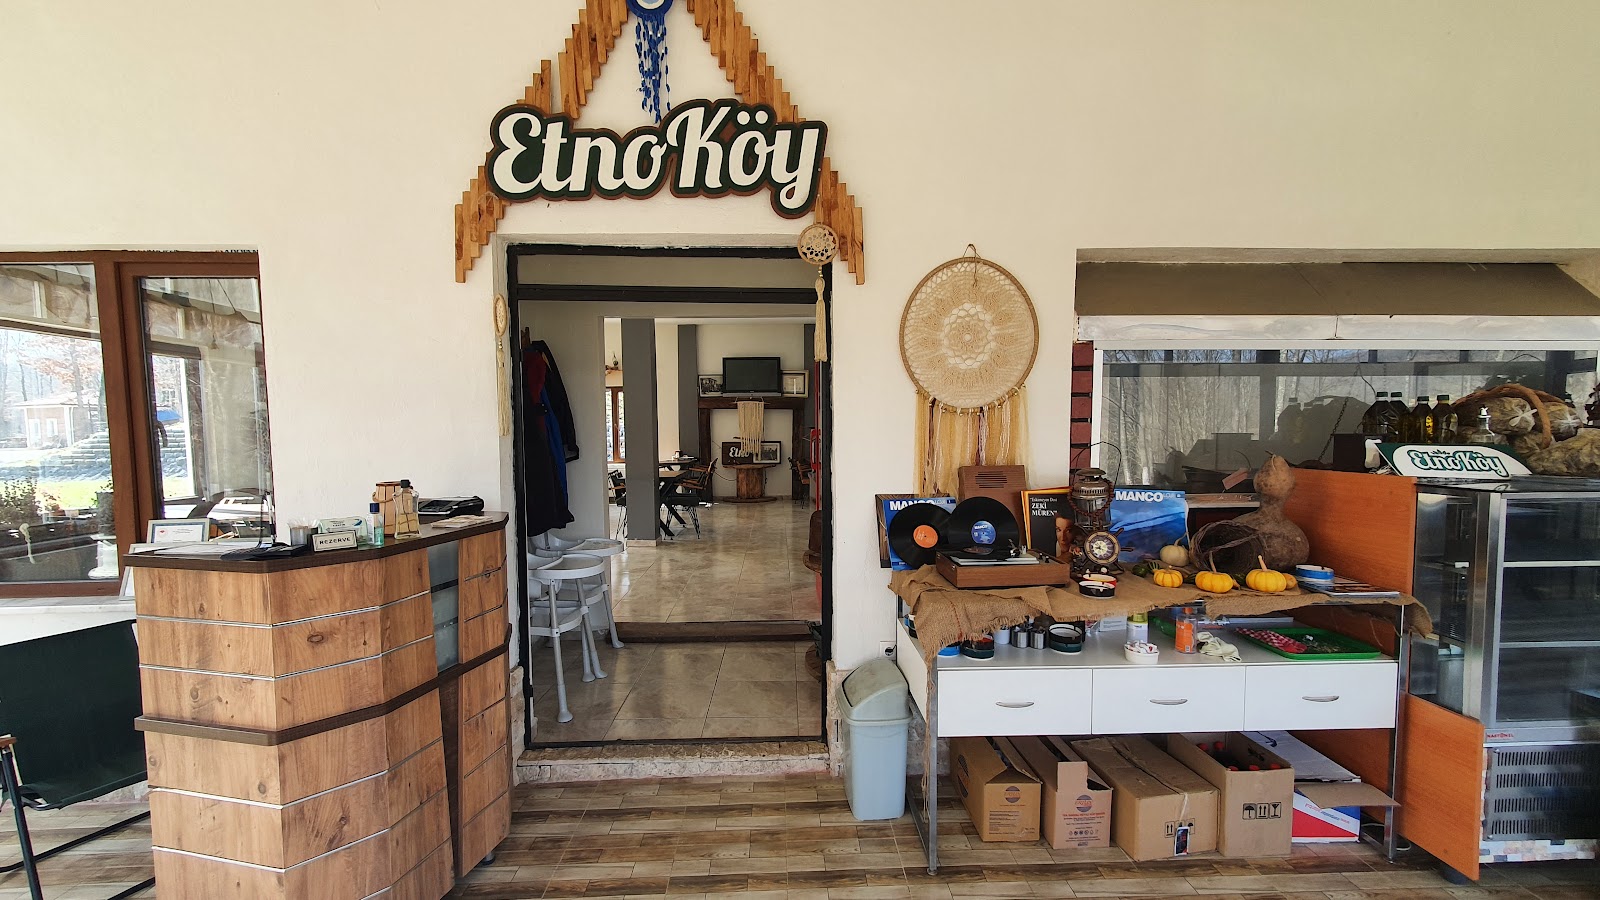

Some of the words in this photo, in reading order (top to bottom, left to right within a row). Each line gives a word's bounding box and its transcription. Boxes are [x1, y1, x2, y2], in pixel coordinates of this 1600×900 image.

[493, 106, 819, 208] EtnoKöy
[1408, 450, 1508, 477] EtnoKöy
[319, 537, 351, 545] REZERVE
